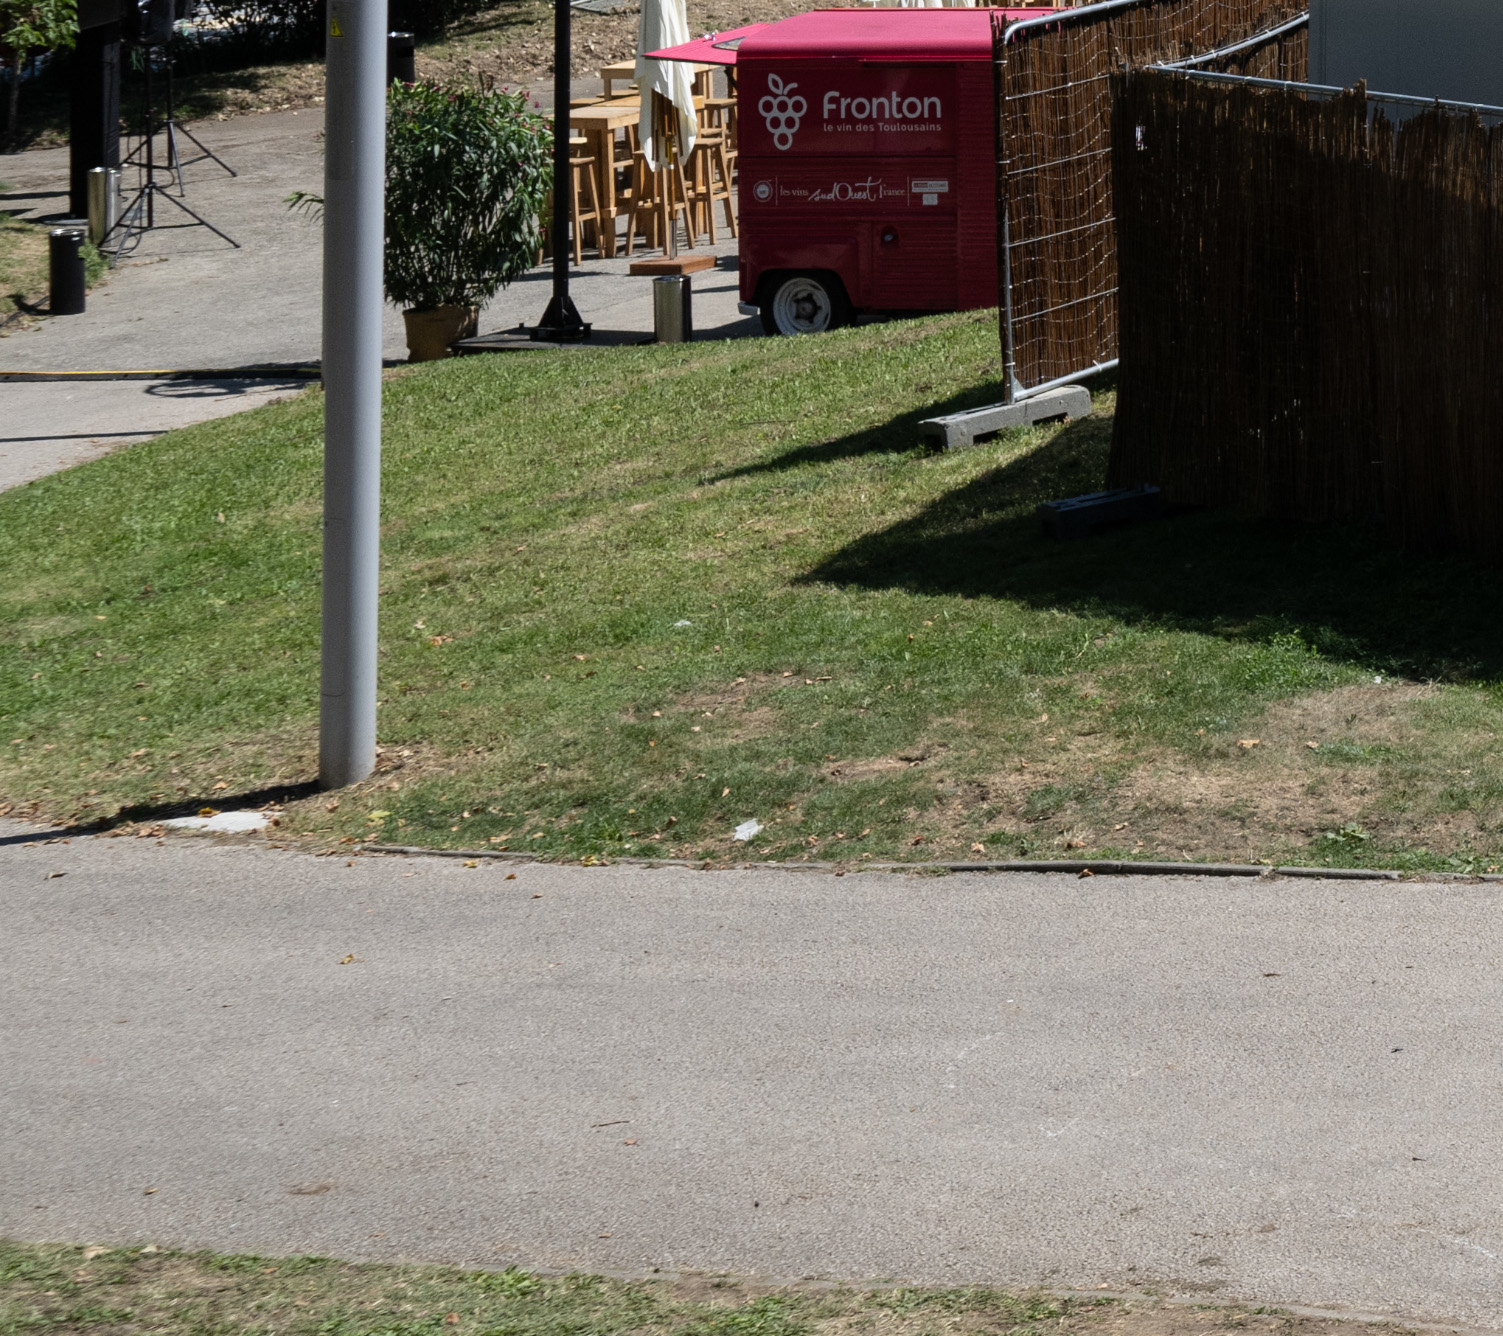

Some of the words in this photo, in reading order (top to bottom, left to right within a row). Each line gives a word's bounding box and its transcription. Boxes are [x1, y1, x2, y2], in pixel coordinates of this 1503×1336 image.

[823, 91, 941, 119] Fronton
[823, 122, 834, 132] le
[836, 122, 852, 132] vin
[856, 122, 875, 132] des
[878, 122, 942, 132] Toulousains
